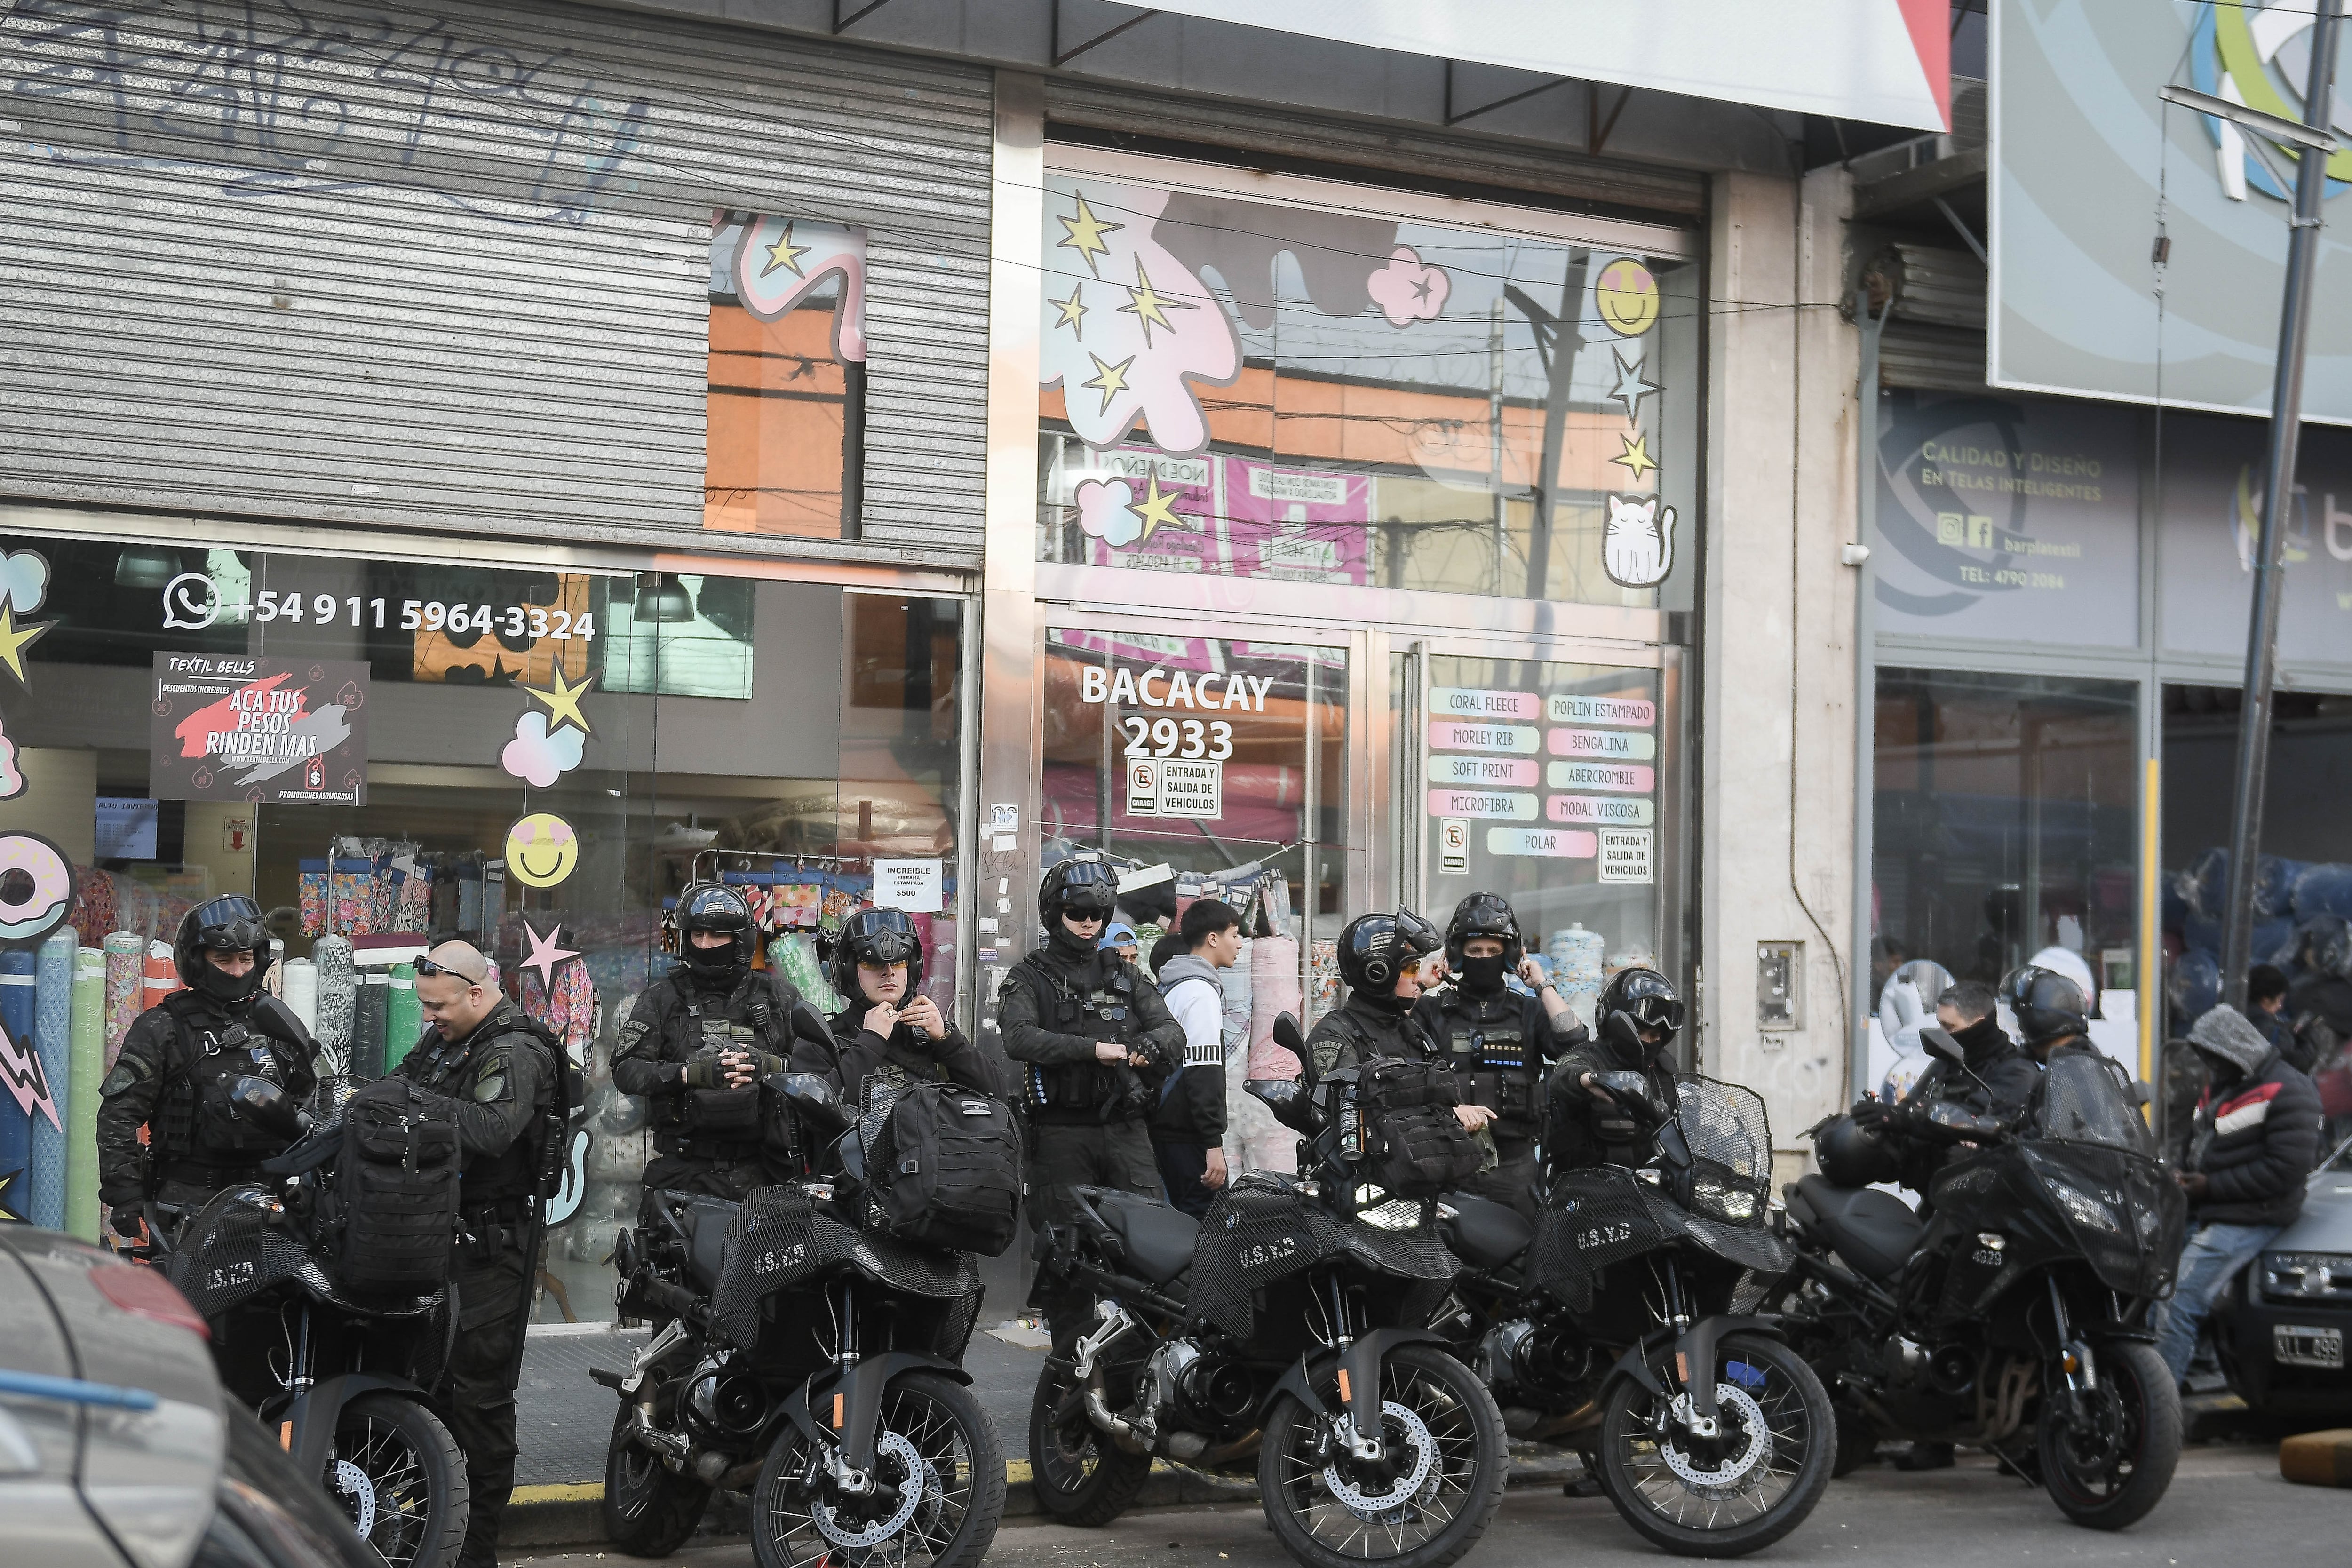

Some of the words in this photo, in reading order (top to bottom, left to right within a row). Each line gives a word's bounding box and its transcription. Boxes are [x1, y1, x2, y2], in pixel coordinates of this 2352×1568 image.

[1923, 441, 2006, 469] CALIDAD
[2014, 453, 2025, 469] Y
[1923, 469, 1943, 486] EN
[1948, 472, 1994, 492] TELAS
[229, 591, 304, 623] +54
[312, 593, 337, 625] 9
[400, 600, 596, 642] 5964-3324
[169, 656, 213, 674] TEXTIL
[217, 660, 256, 676] BELLS
[162, 684, 197, 693] DESCUENTOS
[198, 685, 230, 695] INCREIBLES
[1082, 665, 1274, 712] BACACAY
[229, 689, 263, 712] ACA
[270, 691, 300, 713] TUS
[1450, 694, 1481, 711] CORAL
[1486, 696, 1518, 713] FLEECE
[1554, 700, 1591, 717] POPLIN
[1595, 702, 1650, 720] ESTAMPADO
[238, 711, 292, 734] PESOS
[206, 731, 277, 756] RINDEN
[279, 734, 317, 757] MAS
[1123, 716, 1233, 760] 2933
[1454, 728, 1492, 745] MORLEY
[1496, 731, 1514, 746] RIB
[1572, 735, 1629, 752] BENGALINA
[231, 755, 291, 764] WWW.TEXTILBELLS.COM
[1166, 766, 1206, 778] ENTRADA
[1208, 767, 1215, 779] Y
[1453, 761, 1478, 776] SOFT
[1482, 764, 1514, 779] PRINT
[1568, 768, 1635, 785] ABERCROMBIE
[279, 790, 318, 800] PROMOCIONES
[318, 791, 354, 801] ASOMBROSAS
[1167, 781, 1199, 794] SALIDA
[1201, 782, 1213, 794] DE
[1132, 799, 1154, 808] GARAGE
[1165, 797, 1215, 810] VEHICULOS
[1451, 796, 1515, 813] MICROFIBRA
[1560, 801, 1592, 816] MODAL
[1597, 803, 1640, 818] VISCOSA
[1525, 835, 1556, 850] POLAR
[1605, 836, 1640, 846] ENTRADA
[1641, 836, 1647, 847] Y
[1444, 858, 1464, 866] GARAGE
[1607, 850, 1634, 860] SALIDA
[1636, 851, 1646, 861] DE
[1605, 865, 1647, 876] VEHICULOS
